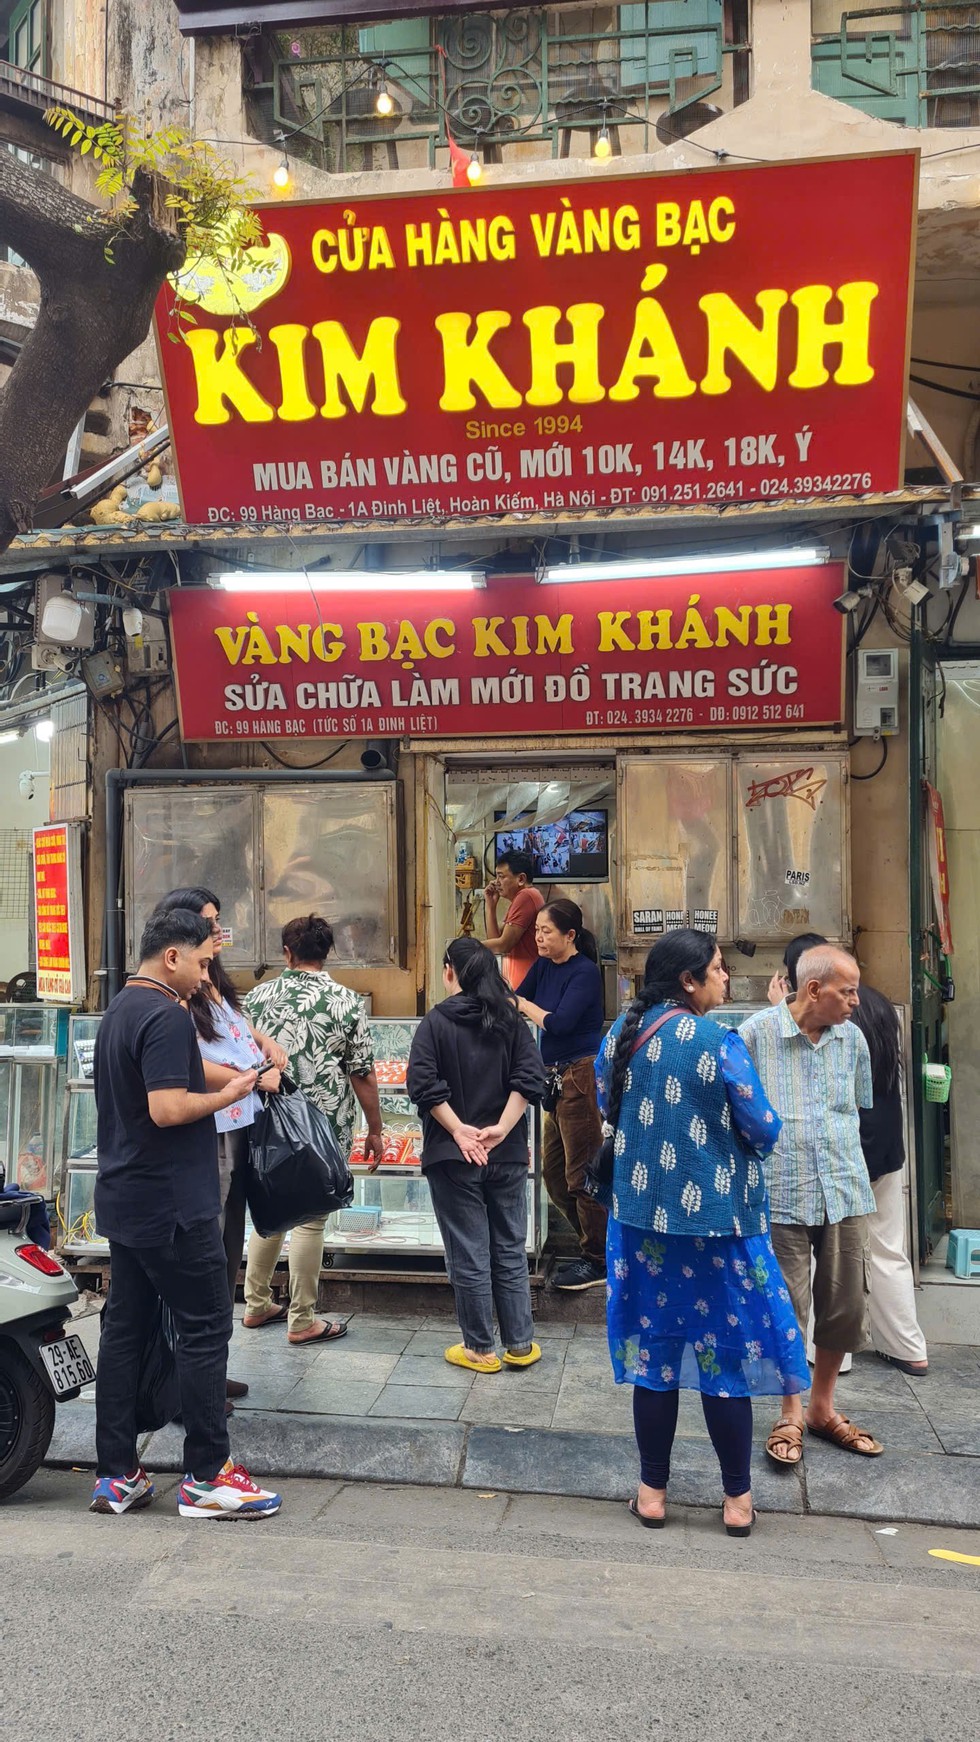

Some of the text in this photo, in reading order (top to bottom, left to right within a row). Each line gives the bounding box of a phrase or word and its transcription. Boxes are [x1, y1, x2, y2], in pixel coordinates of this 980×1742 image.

[312, 197, 735, 273] CỬA HÀNG VÀNG BẠC
[185, 263, 878, 425] KIM KHÁNH
[466, 415, 582, 438] Since 1994
[253, 425, 812, 491] MUA BÁN VÀNG CŨ, MỚI 10K, 14K, 18K, Ý
[208, 507, 235, 522] ĐC:
[240, 507, 257, 521] 99
[262, 505, 300, 521] Hàng
[349, 502, 368, 516] 1A
[373, 500, 406, 516] Đinh
[450, 496, 489, 512] Hoàn
[496, 492, 538, 511] Kiếm,
[544, 492, 564, 507] Hà
[570, 490, 594, 507] Nội
[642, 481, 742, 503] 091.251.2641
[761, 473, 872, 496] 024.39342276
[215, 594, 792, 669] VÀNG BẠC KIM KHÁNH
[225, 660, 797, 710] SỬA CHỮA LÀM MỚI ĐỒ TRANG SỨC
[215, 721, 232, 734] ĐC:
[236, 721, 249, 733] 99
[253, 720, 281, 733] HÀNG
[361, 718, 373, 731] 1A
[379, 717, 404, 731] ĐINH
[586, 711, 603, 725] ĐT:
[667, 708, 692, 722] 2276
[710, 707, 729, 720] DĐ:
[733, 706, 758, 720] 0912
[763, 705, 781, 719] 512
[786, 704, 803, 718] 641
[786, 870, 810, 882] PARIS
[633, 910, 662, 923] SARAN
[694, 910, 718, 920] HONEE
[48, 1339, 81, 1366] 29-AE
[53, 1359, 93, 1390] 815.60
